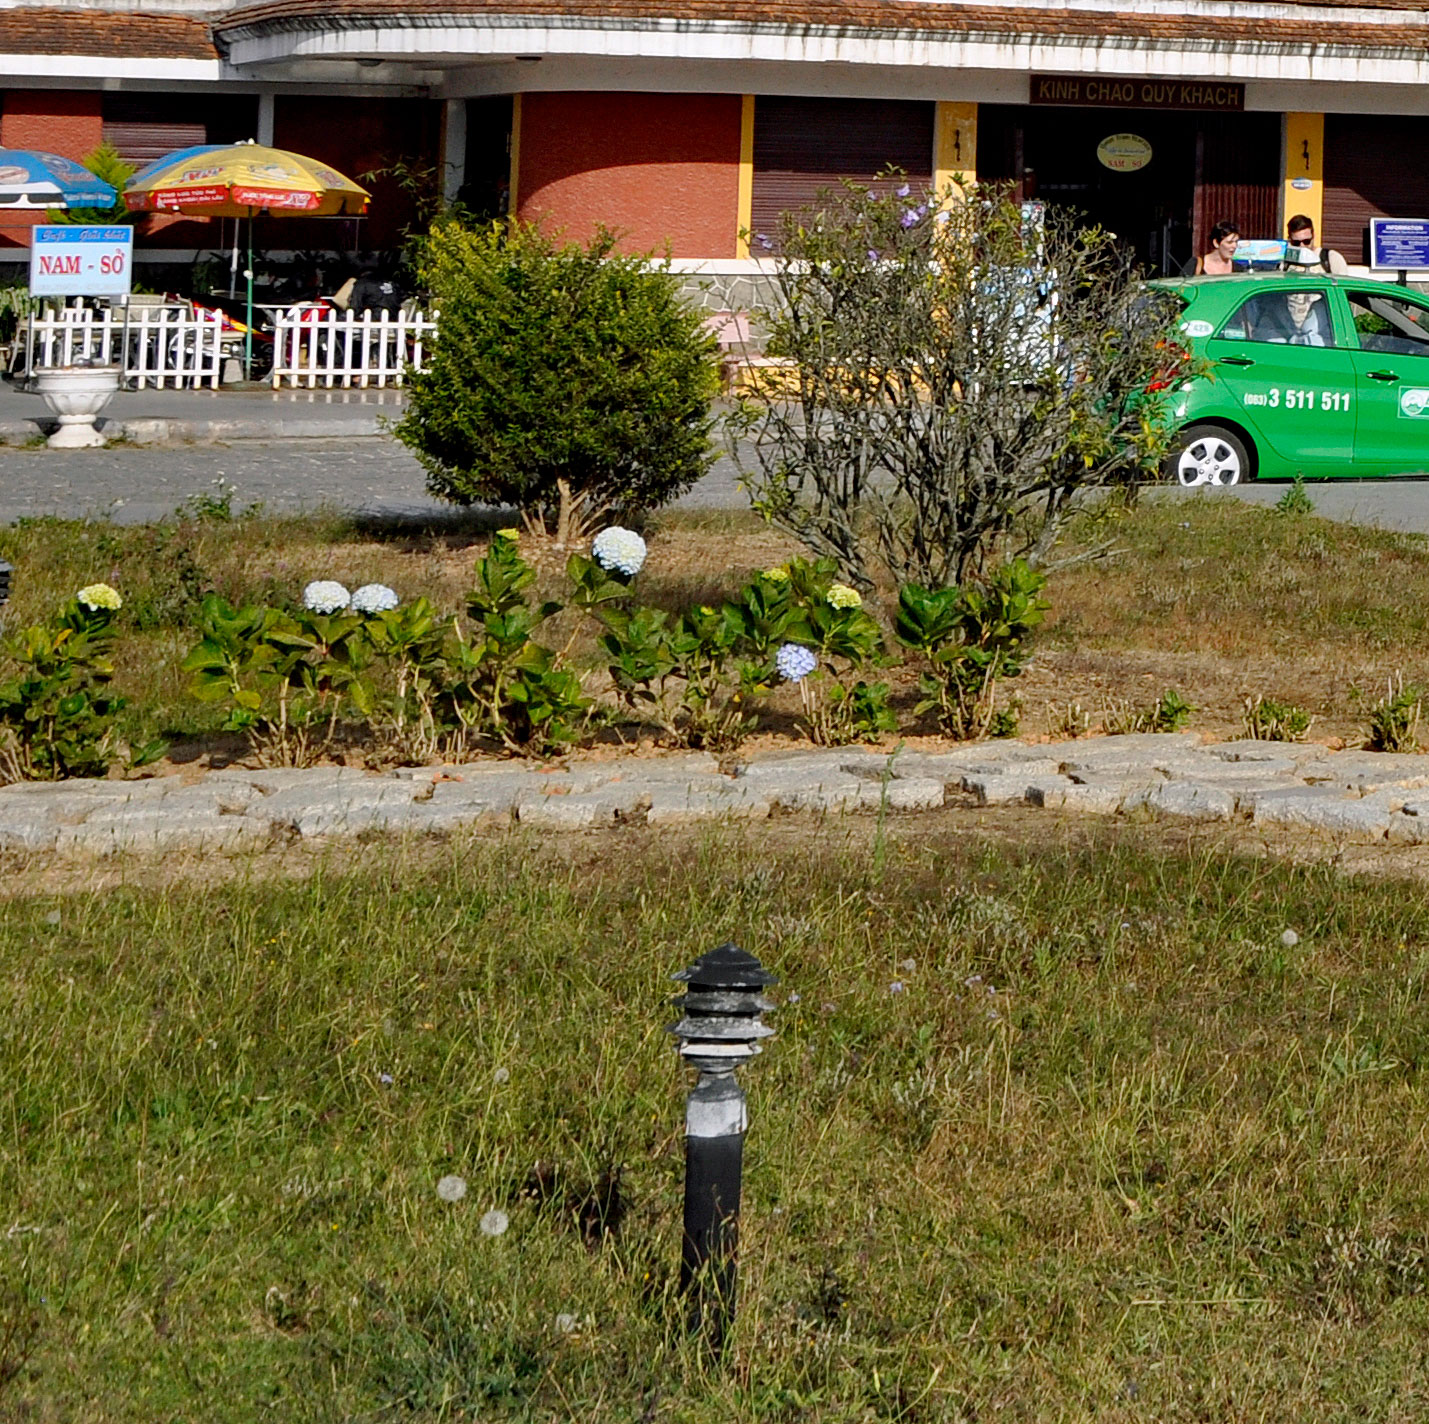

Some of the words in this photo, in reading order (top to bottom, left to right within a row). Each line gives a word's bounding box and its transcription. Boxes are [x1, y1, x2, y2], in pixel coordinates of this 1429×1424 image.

[39, 255, 83, 275] NAM
[1268, 388, 1279, 408] 3
[1285, 390, 1314, 410] 511
[1321, 392, 1350, 412] 511
